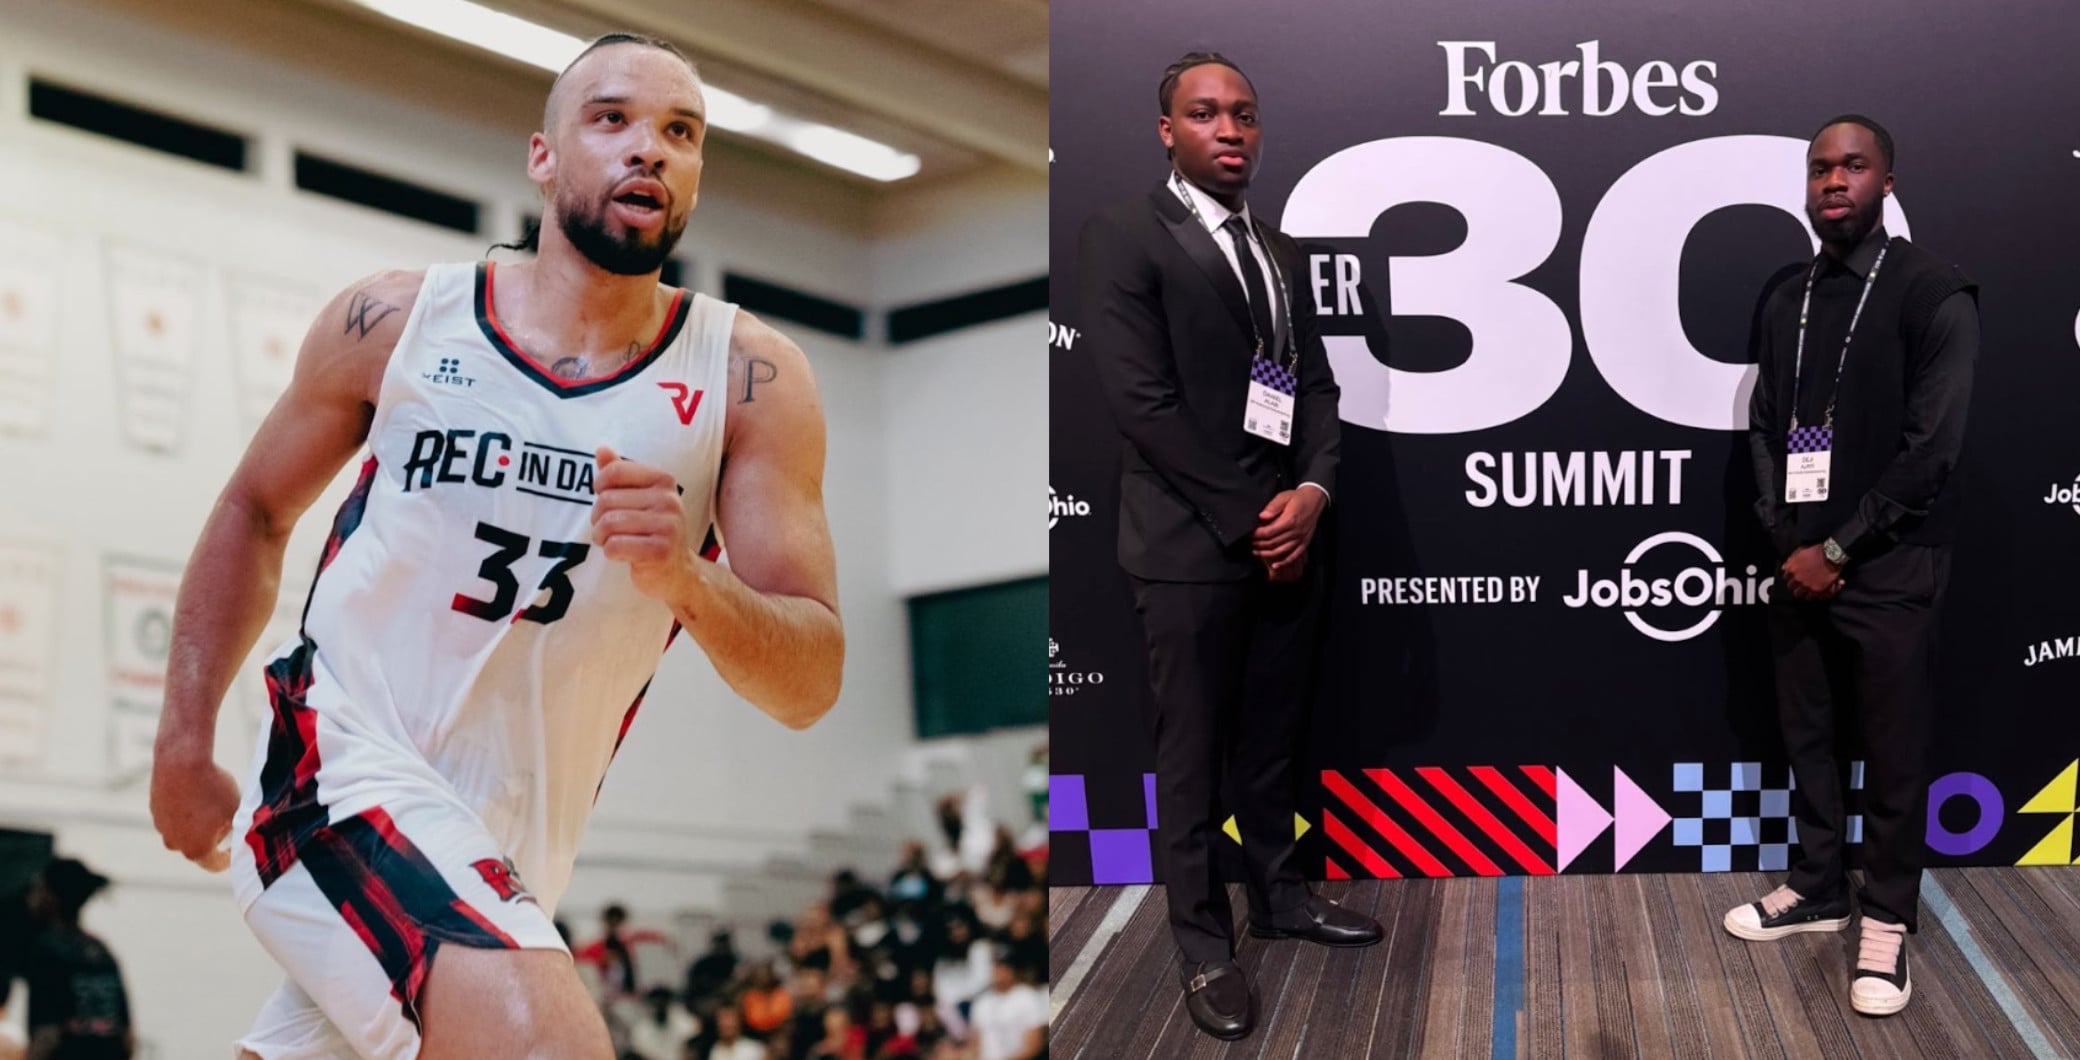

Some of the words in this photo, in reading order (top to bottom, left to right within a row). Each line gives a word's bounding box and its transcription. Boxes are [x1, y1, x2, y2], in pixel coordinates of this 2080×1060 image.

[1437, 39, 1719, 117] Forbes
[1280, 134, 1911, 435] 30
[518, 451, 551, 486] IN
[1465, 449, 1692, 508] SUMMIT
[1049, 494, 1091, 516] hio
[451, 521, 591, 626] 33
[1361, 576, 1503, 606] PRESENTED
[1510, 575, 1541, 604] BY
